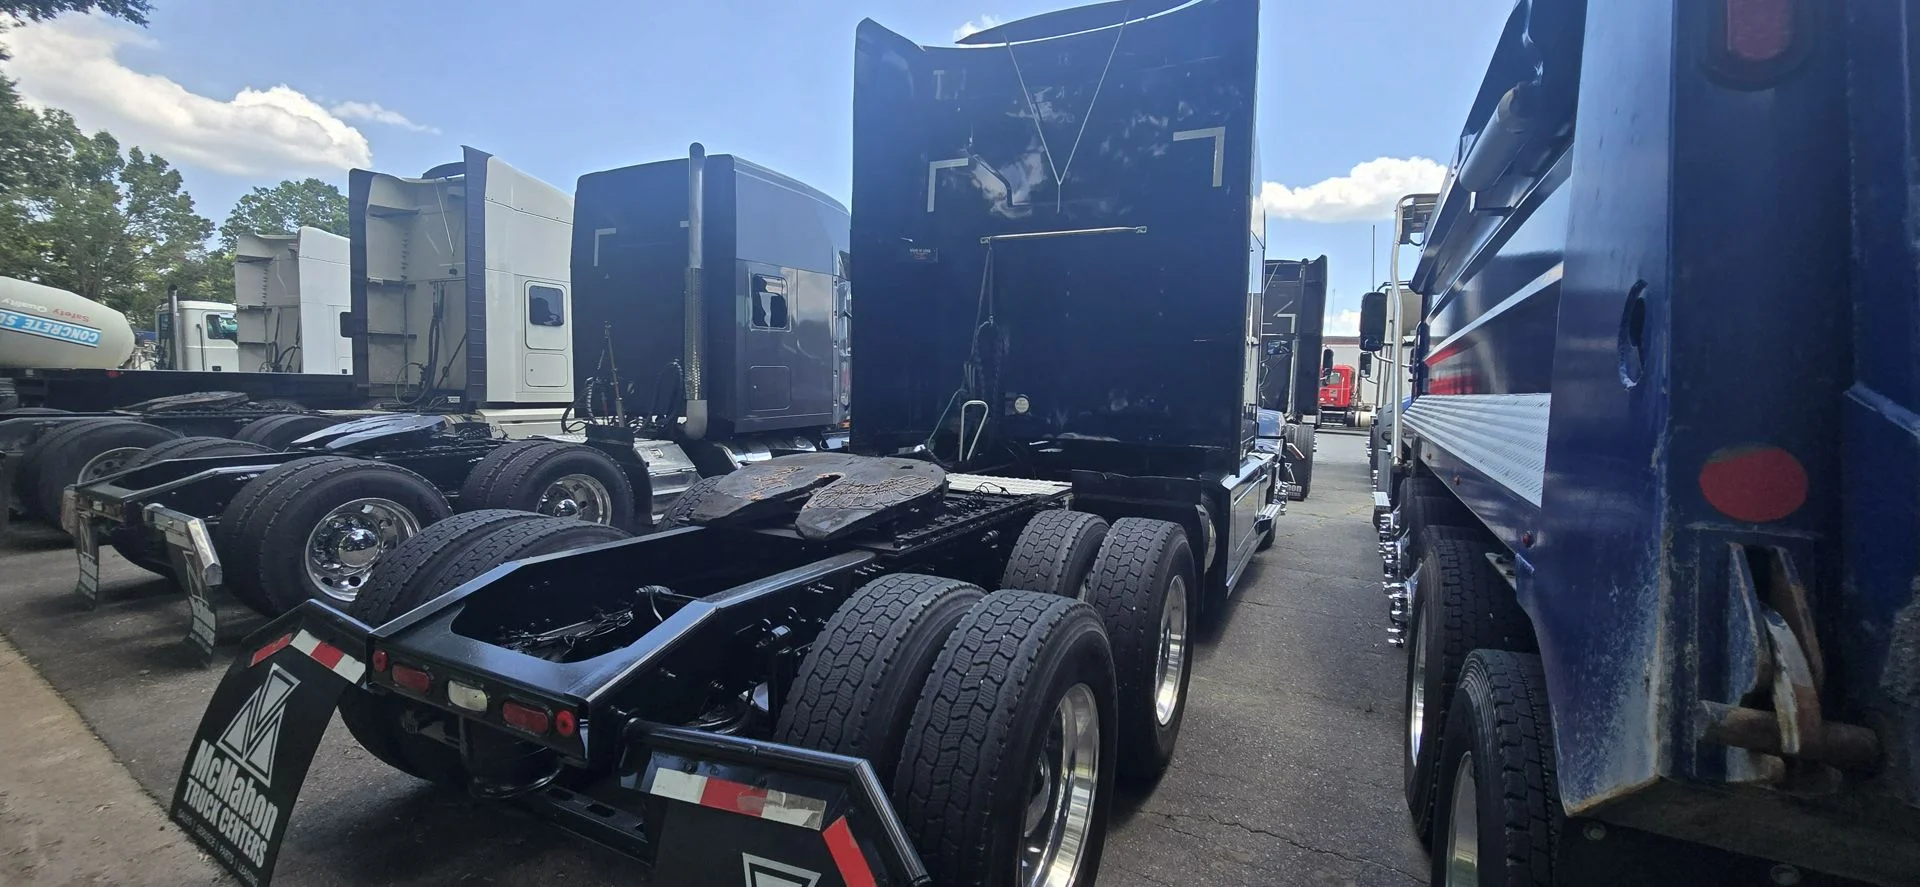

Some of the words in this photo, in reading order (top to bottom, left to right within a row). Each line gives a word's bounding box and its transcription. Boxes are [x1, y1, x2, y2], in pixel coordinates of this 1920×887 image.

[21, 319, 98, 342] CONCRETE
[183, 778, 222, 826] TRUCK
[219, 807, 267, 868] CENTERS
[190, 739, 279, 841] McMahon
